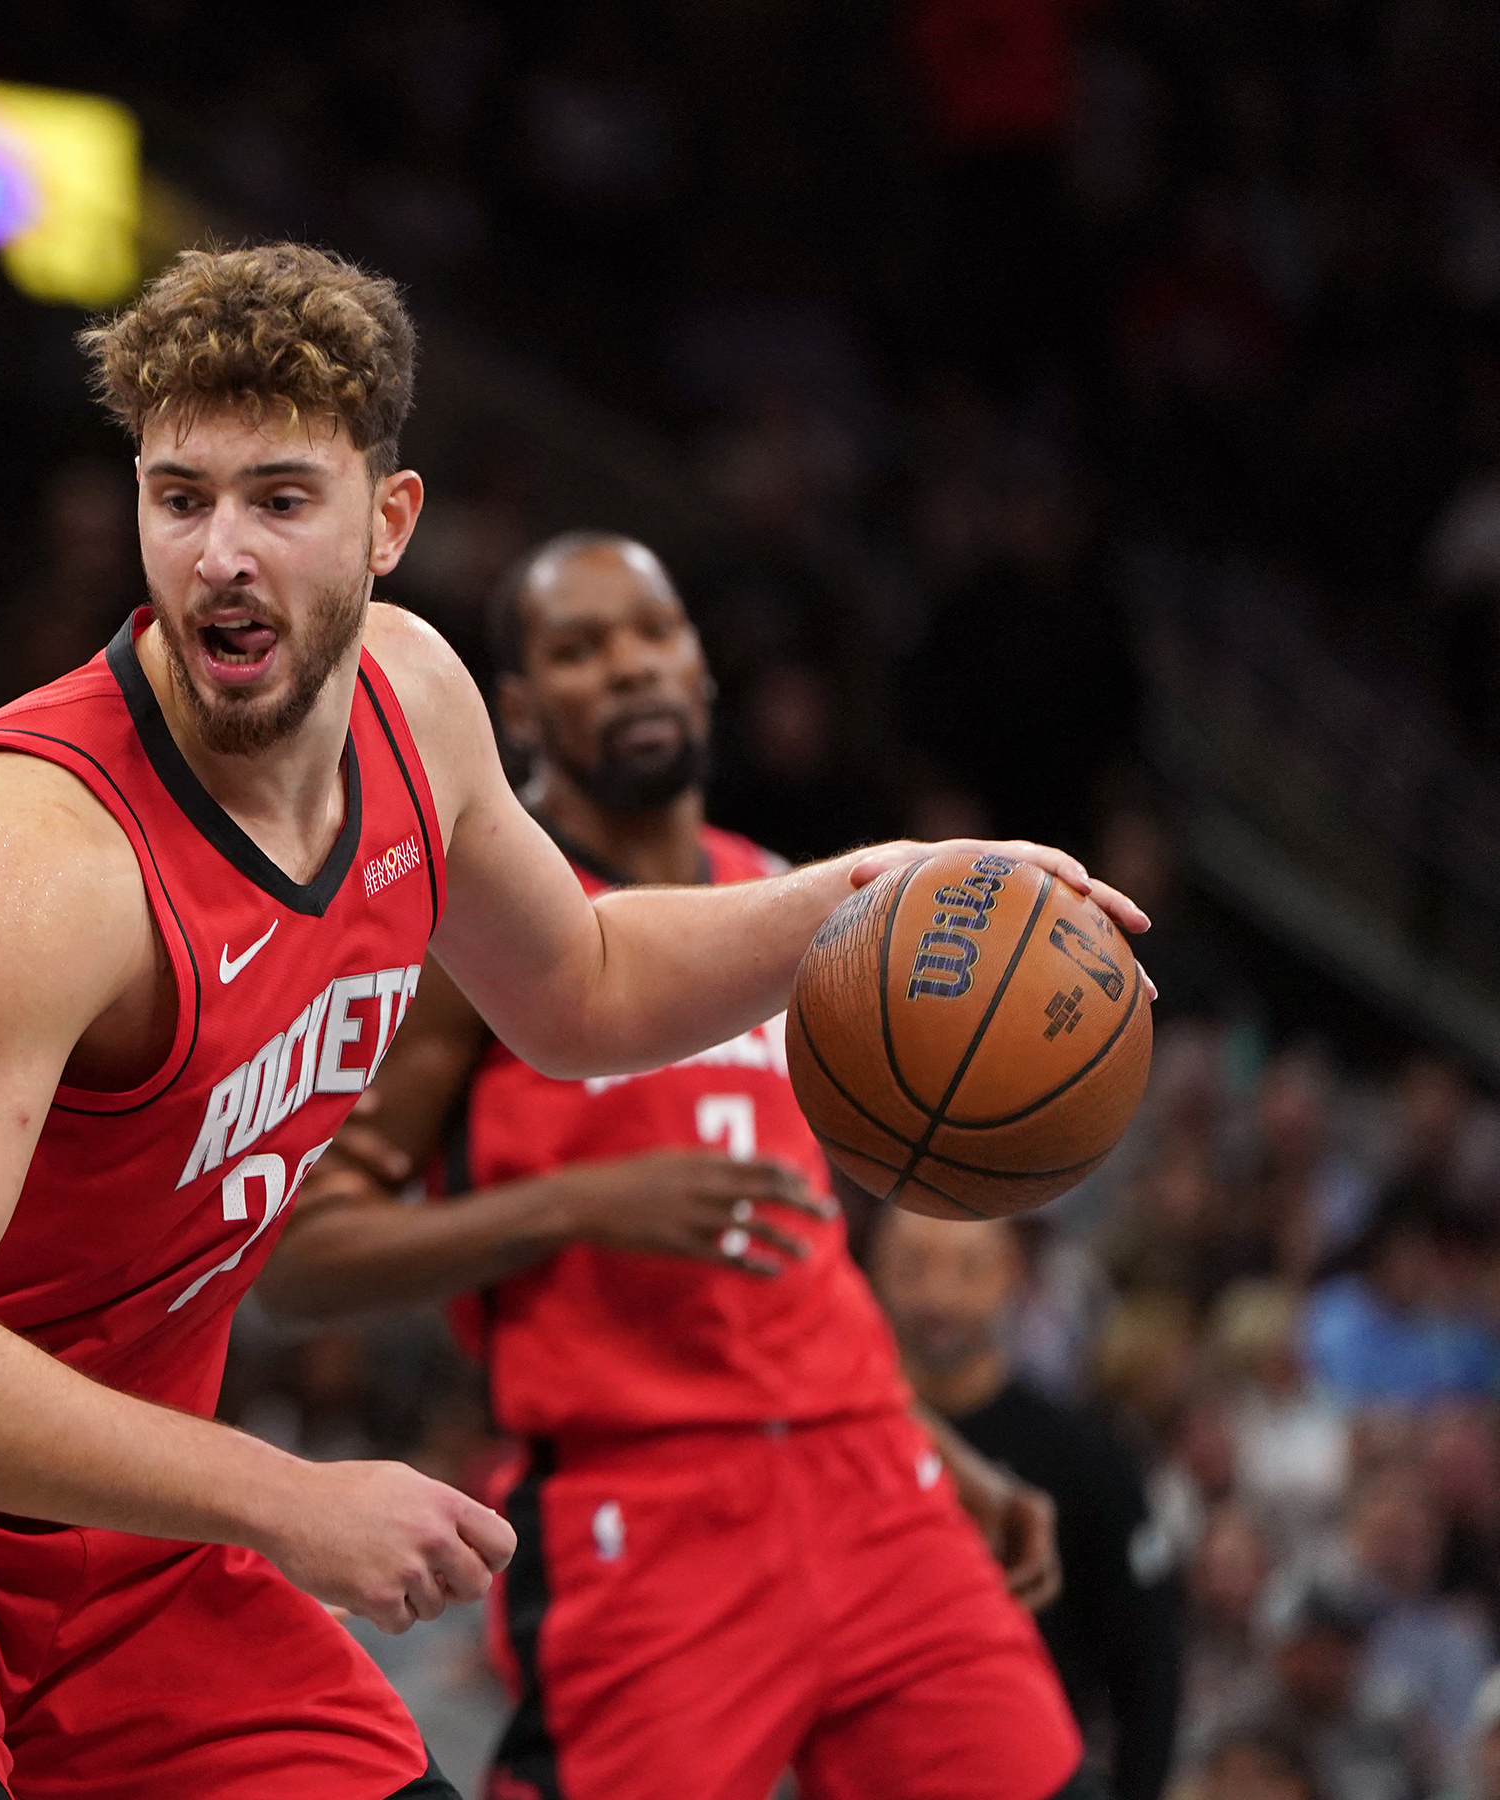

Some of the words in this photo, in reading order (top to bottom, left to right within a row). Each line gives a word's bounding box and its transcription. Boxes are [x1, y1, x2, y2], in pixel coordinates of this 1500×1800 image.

[363, 835, 418, 881] MEMORIAL
[364, 849, 420, 898] HERMANN
[167, 1138, 333, 1313] 2
